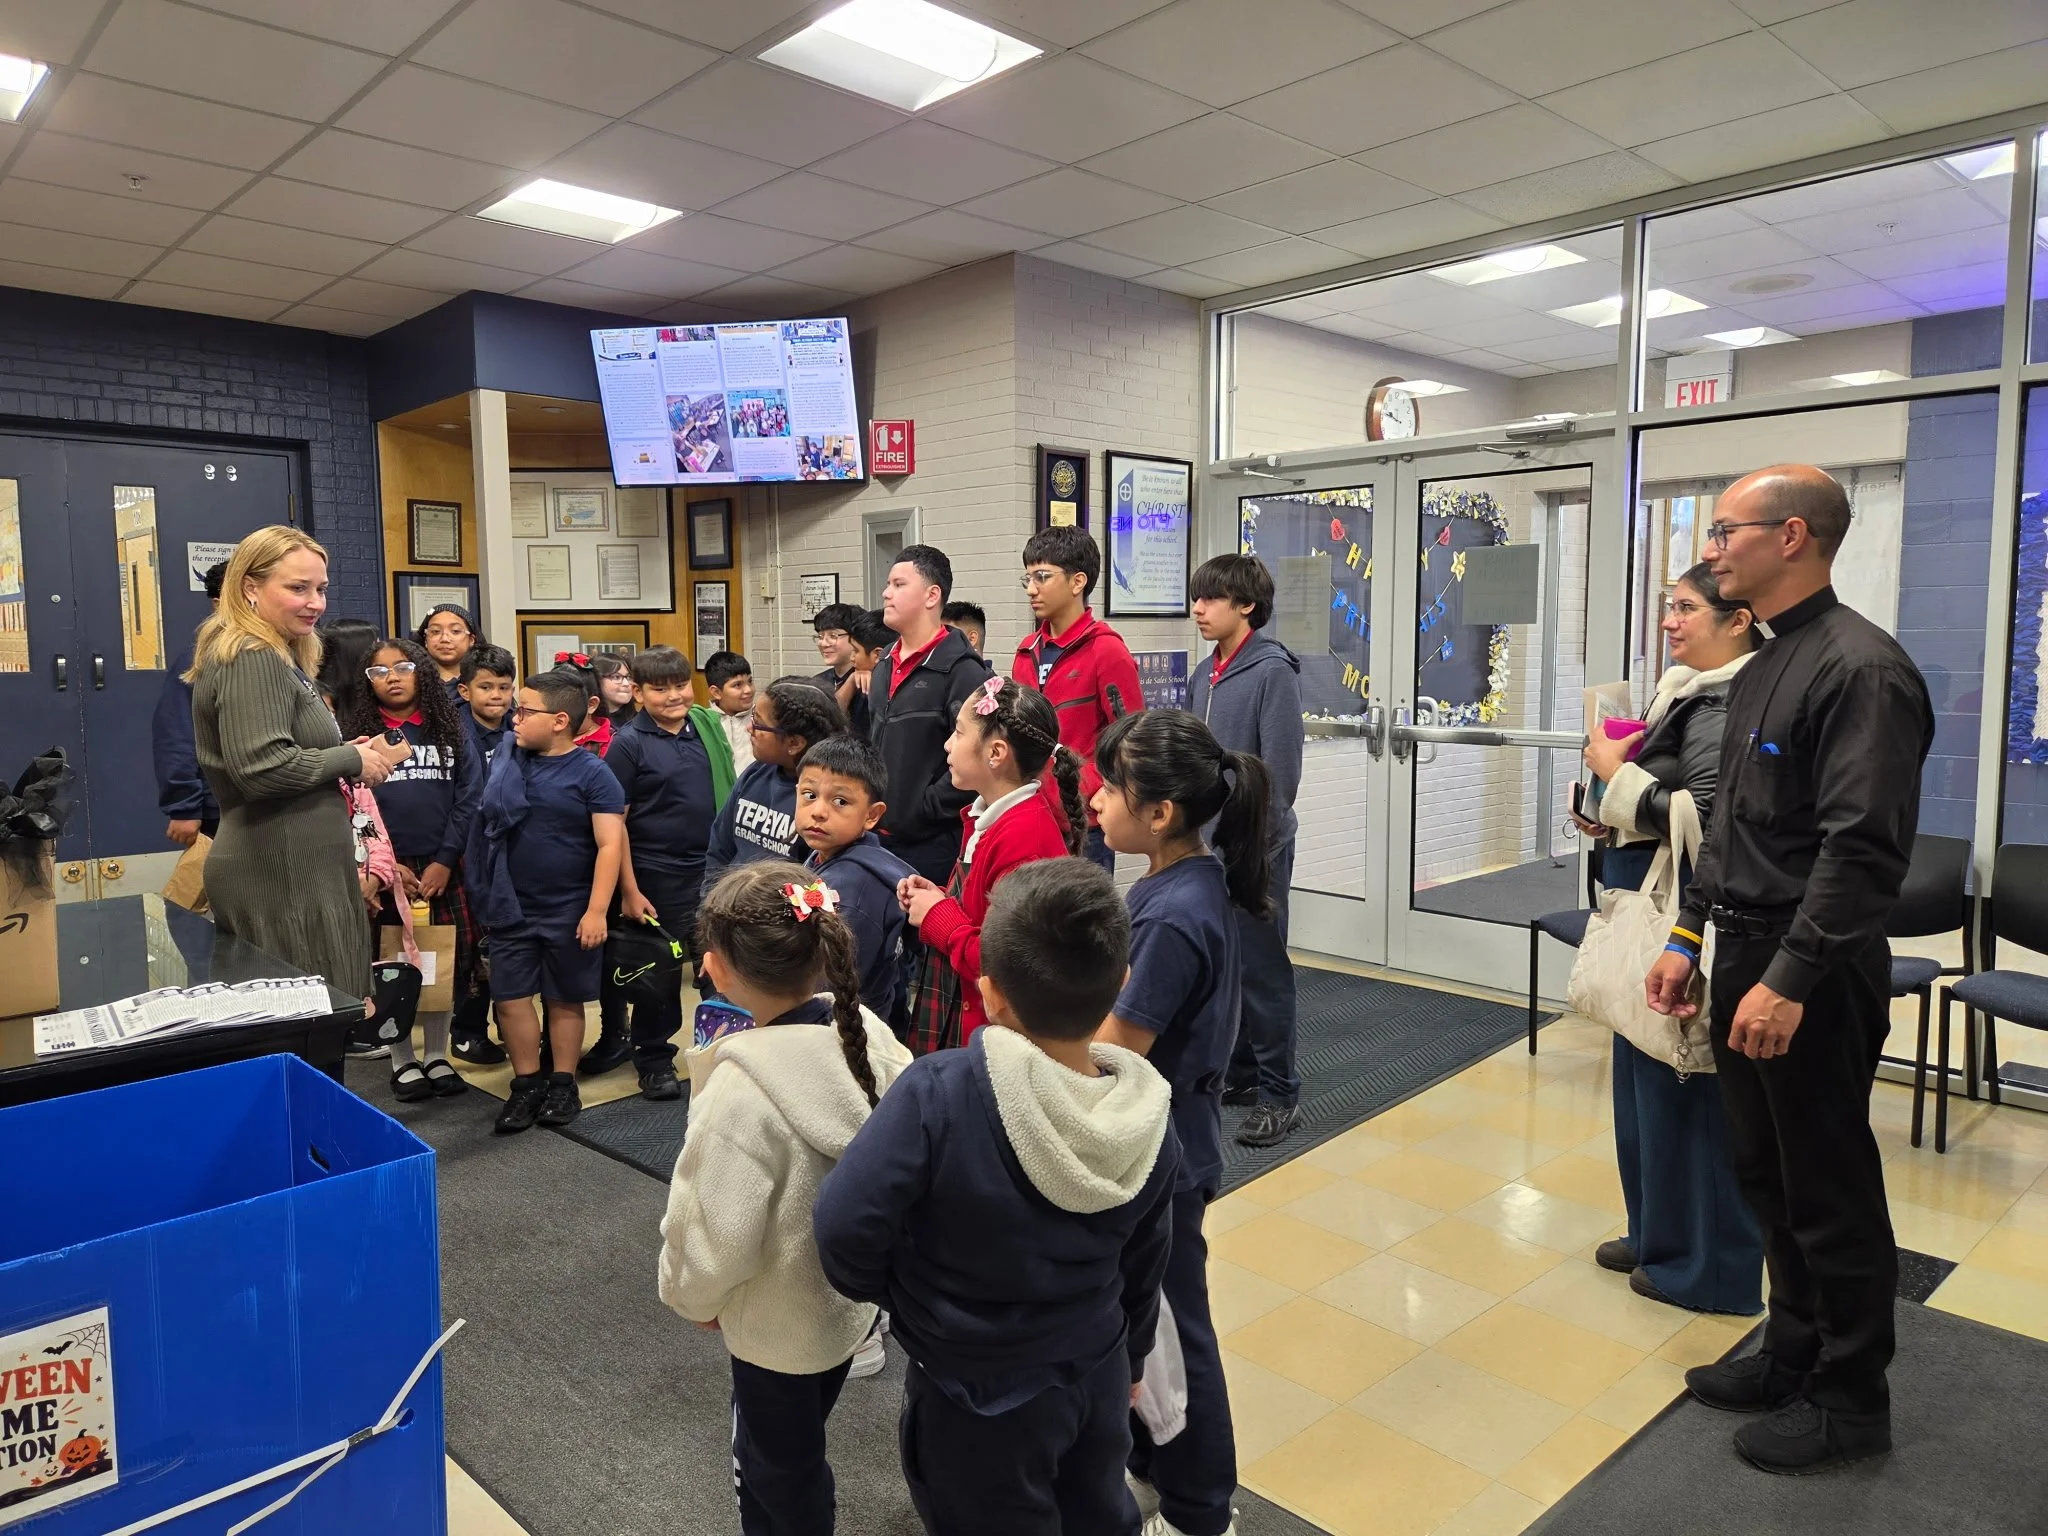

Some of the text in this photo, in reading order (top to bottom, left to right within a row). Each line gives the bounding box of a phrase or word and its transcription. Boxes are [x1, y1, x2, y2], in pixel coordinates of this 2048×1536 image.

[1676, 379, 1718, 407] EXIT
[875, 451, 905, 463] FIRE
[1136, 500, 1187, 519] CHRIST
[195, 545, 216, 553] Please
[218, 546, 231, 555] sign
[192, 554, 203, 562] the
[1145, 676, 1153, 685] de
[1154, 676, 1167, 684] Sales
[1168, 675, 1186, 684] School
[734, 826, 791, 857] GRADE SCHOOL
